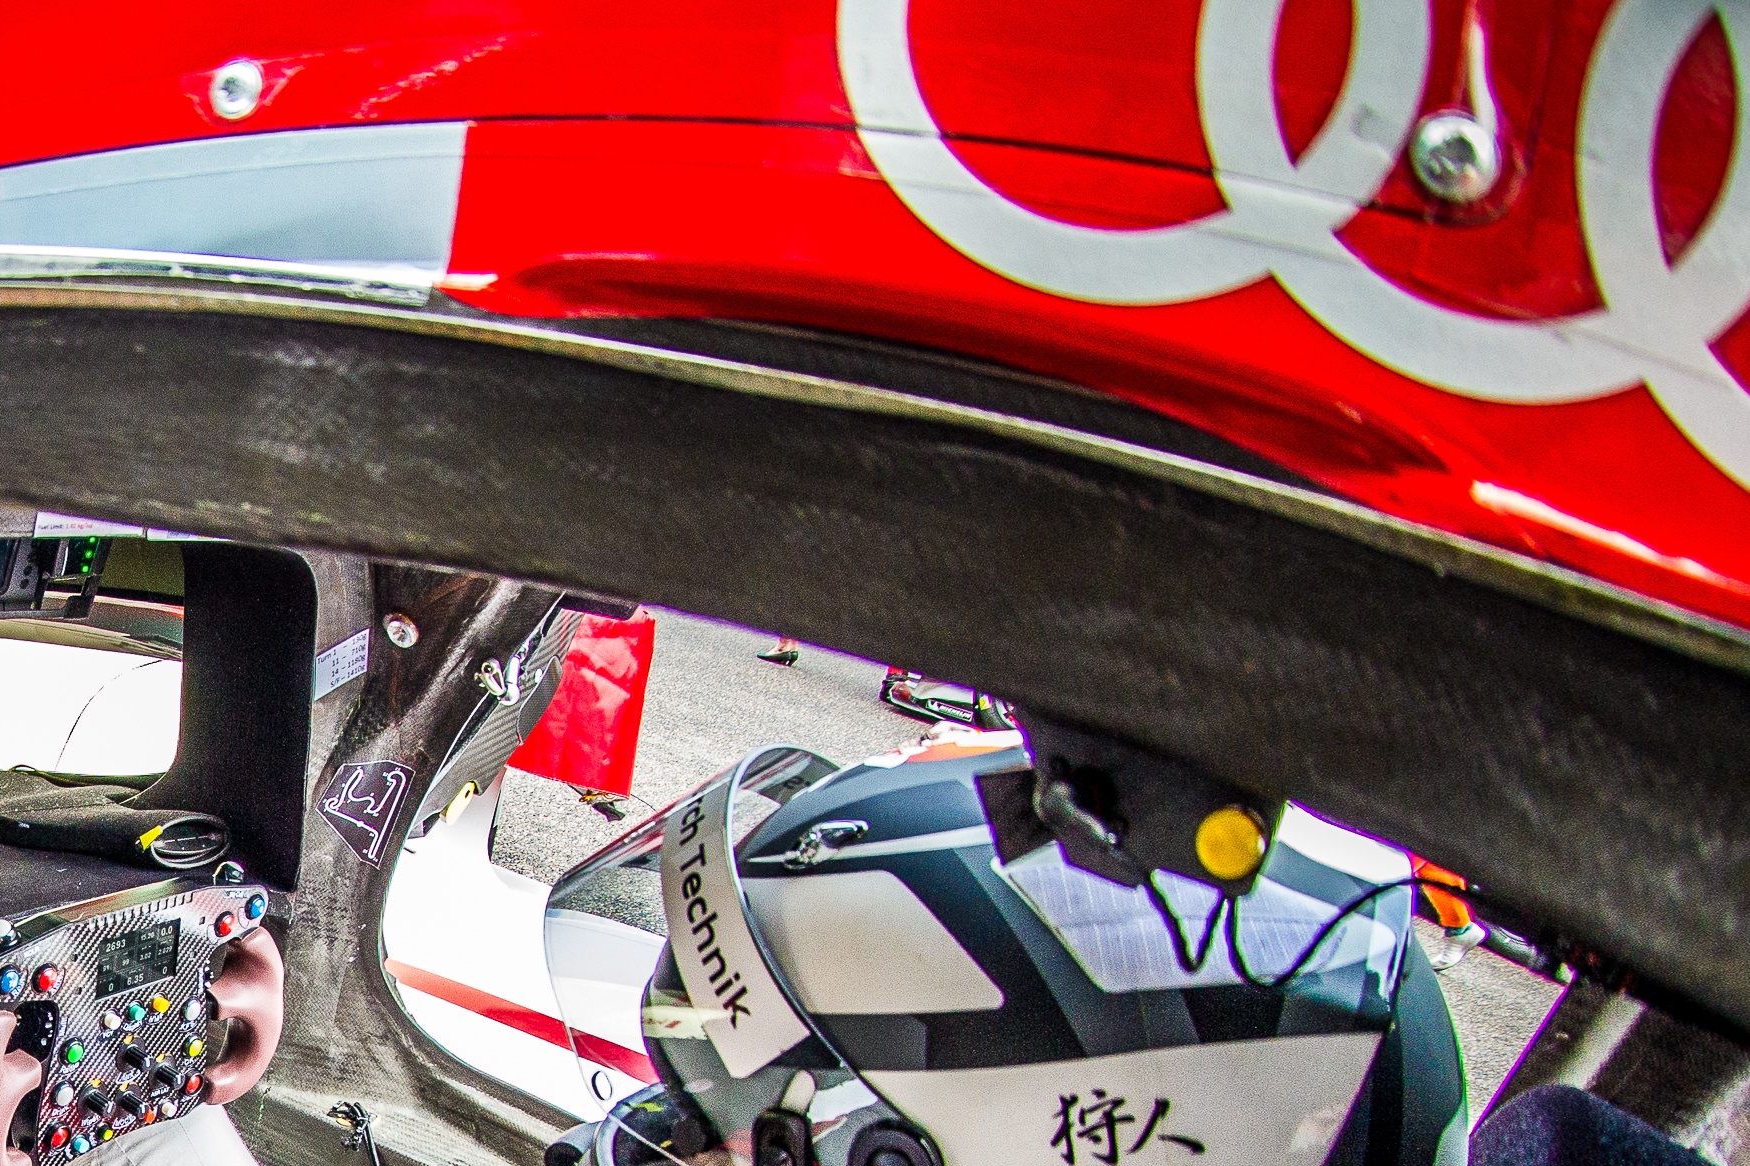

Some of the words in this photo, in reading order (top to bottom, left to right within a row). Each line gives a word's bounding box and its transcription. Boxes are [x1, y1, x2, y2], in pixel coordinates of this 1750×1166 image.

[317, 653, 332, 665] Turn
[331, 658, 339, 667] 11
[680, 843, 751, 1030] Technik
[105, 939, 126, 953] 2693
[108, 983, 114, 992] 0
[162, 966, 168, 975] 0
